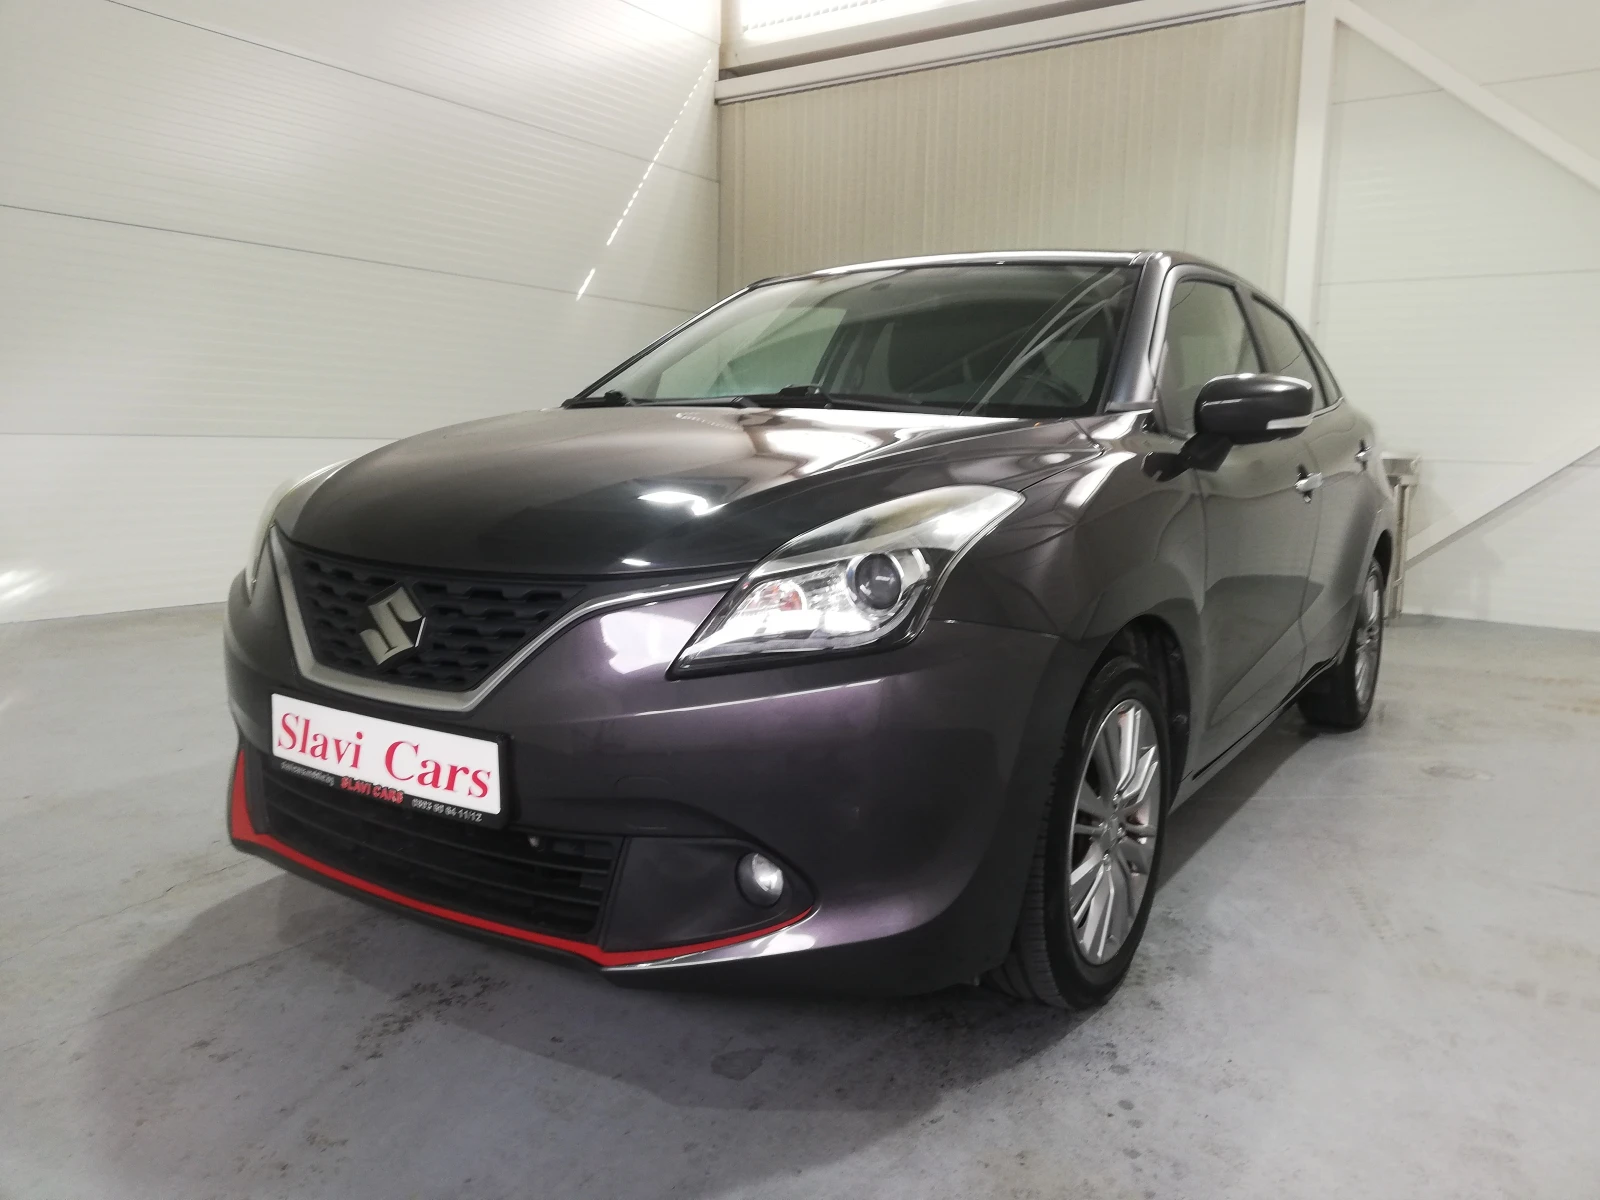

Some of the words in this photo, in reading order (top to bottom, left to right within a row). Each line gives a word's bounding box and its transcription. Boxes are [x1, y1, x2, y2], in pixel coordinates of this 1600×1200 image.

[278, 712, 363, 769] Slavi
[385, 741, 491, 798] Cars
[372, 784, 404, 804] CARS
